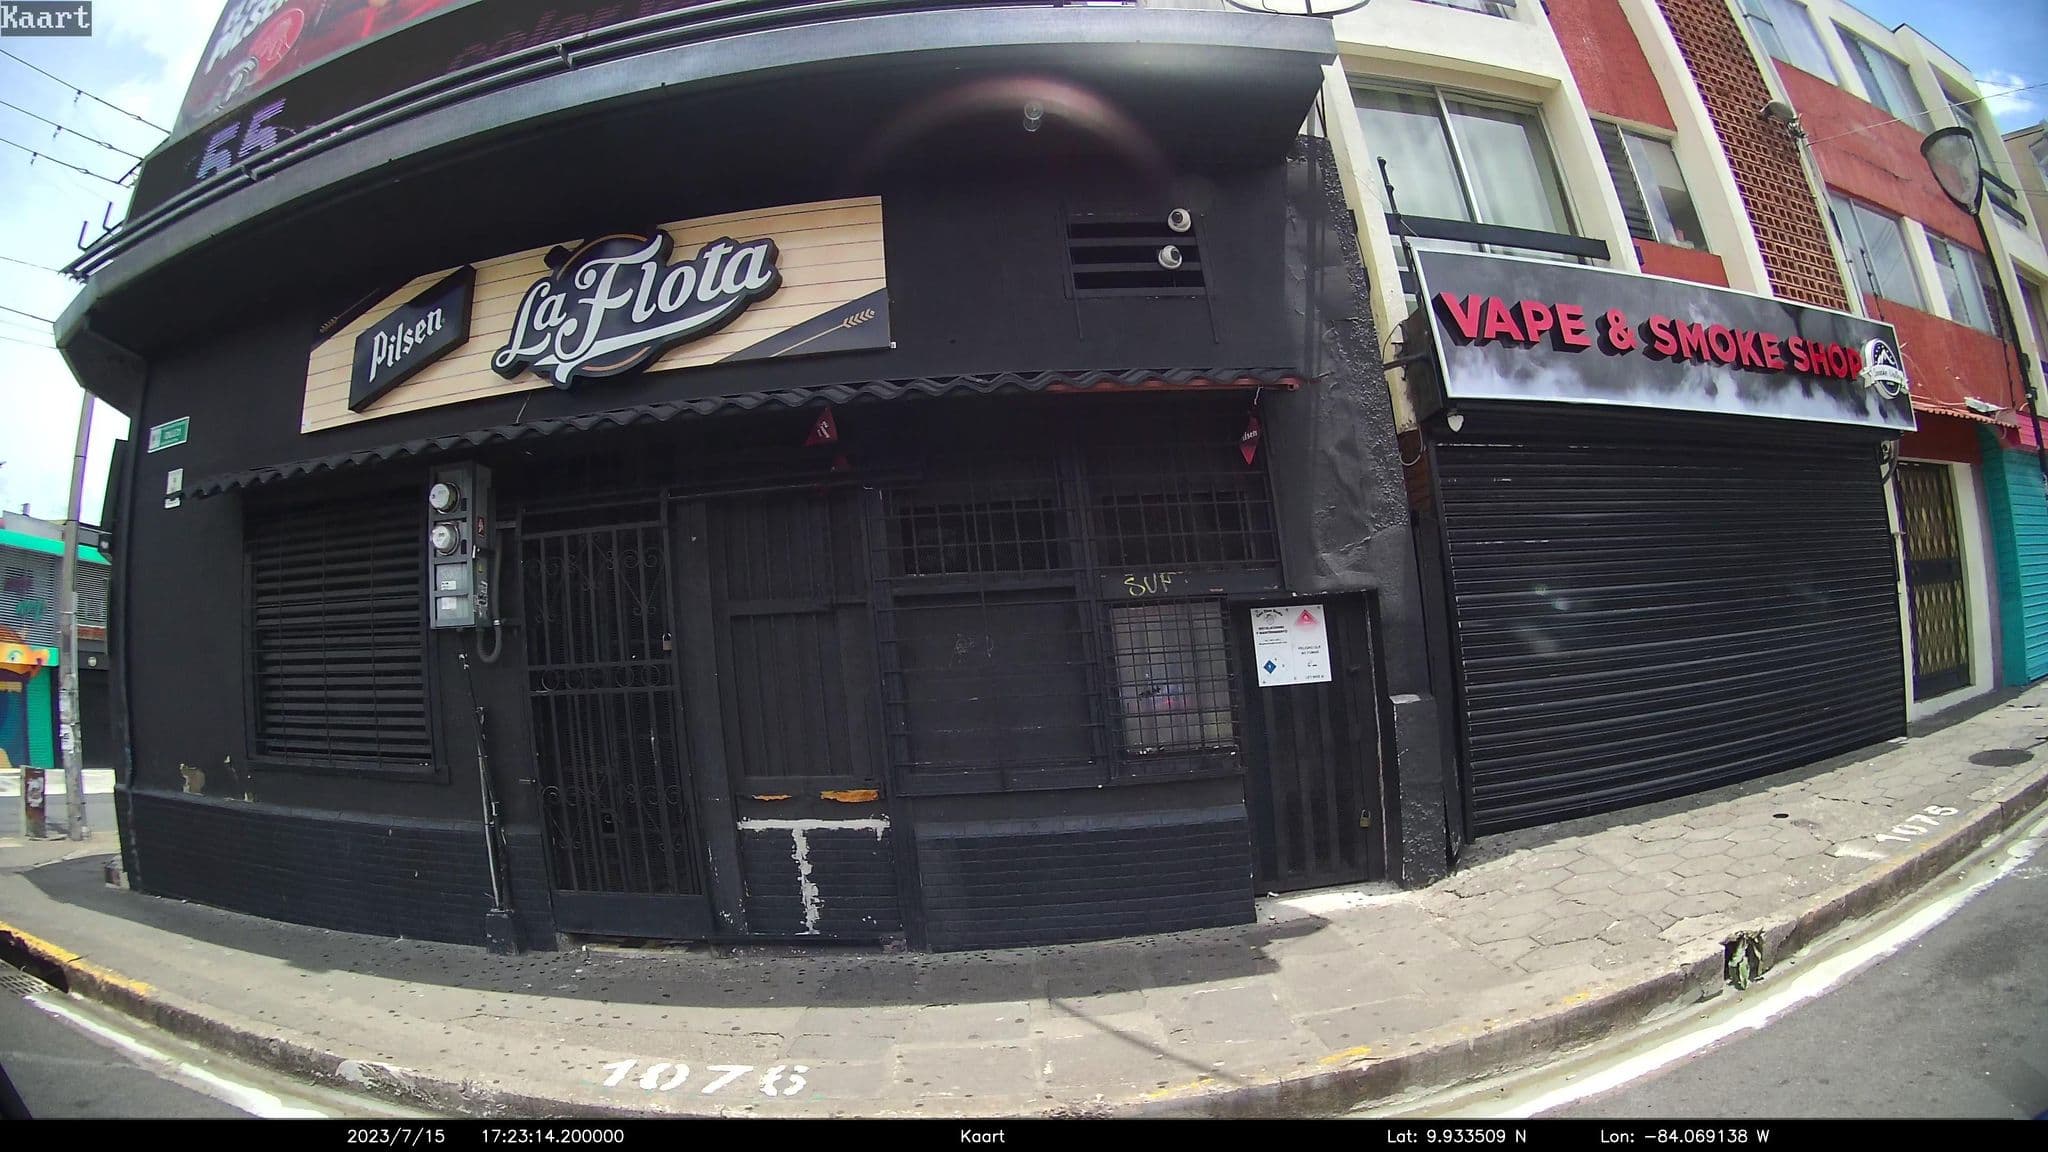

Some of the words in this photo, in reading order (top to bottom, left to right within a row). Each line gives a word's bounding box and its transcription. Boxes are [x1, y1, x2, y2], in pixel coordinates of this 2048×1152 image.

[496, 281, 567, 368] La
[555, 234, 773, 362] Flota
[1436, 291, 1592, 349] VAPE
[1602, 307, 1639, 352] &
[1647, 313, 1785, 370] SMOKE
[1787, 336, 1863, 380] SHOP
[369, 307, 444, 384] Pilsen
[1874, 804, 1959, 842] 1075
[602, 1058, 810, 1097] 1076
